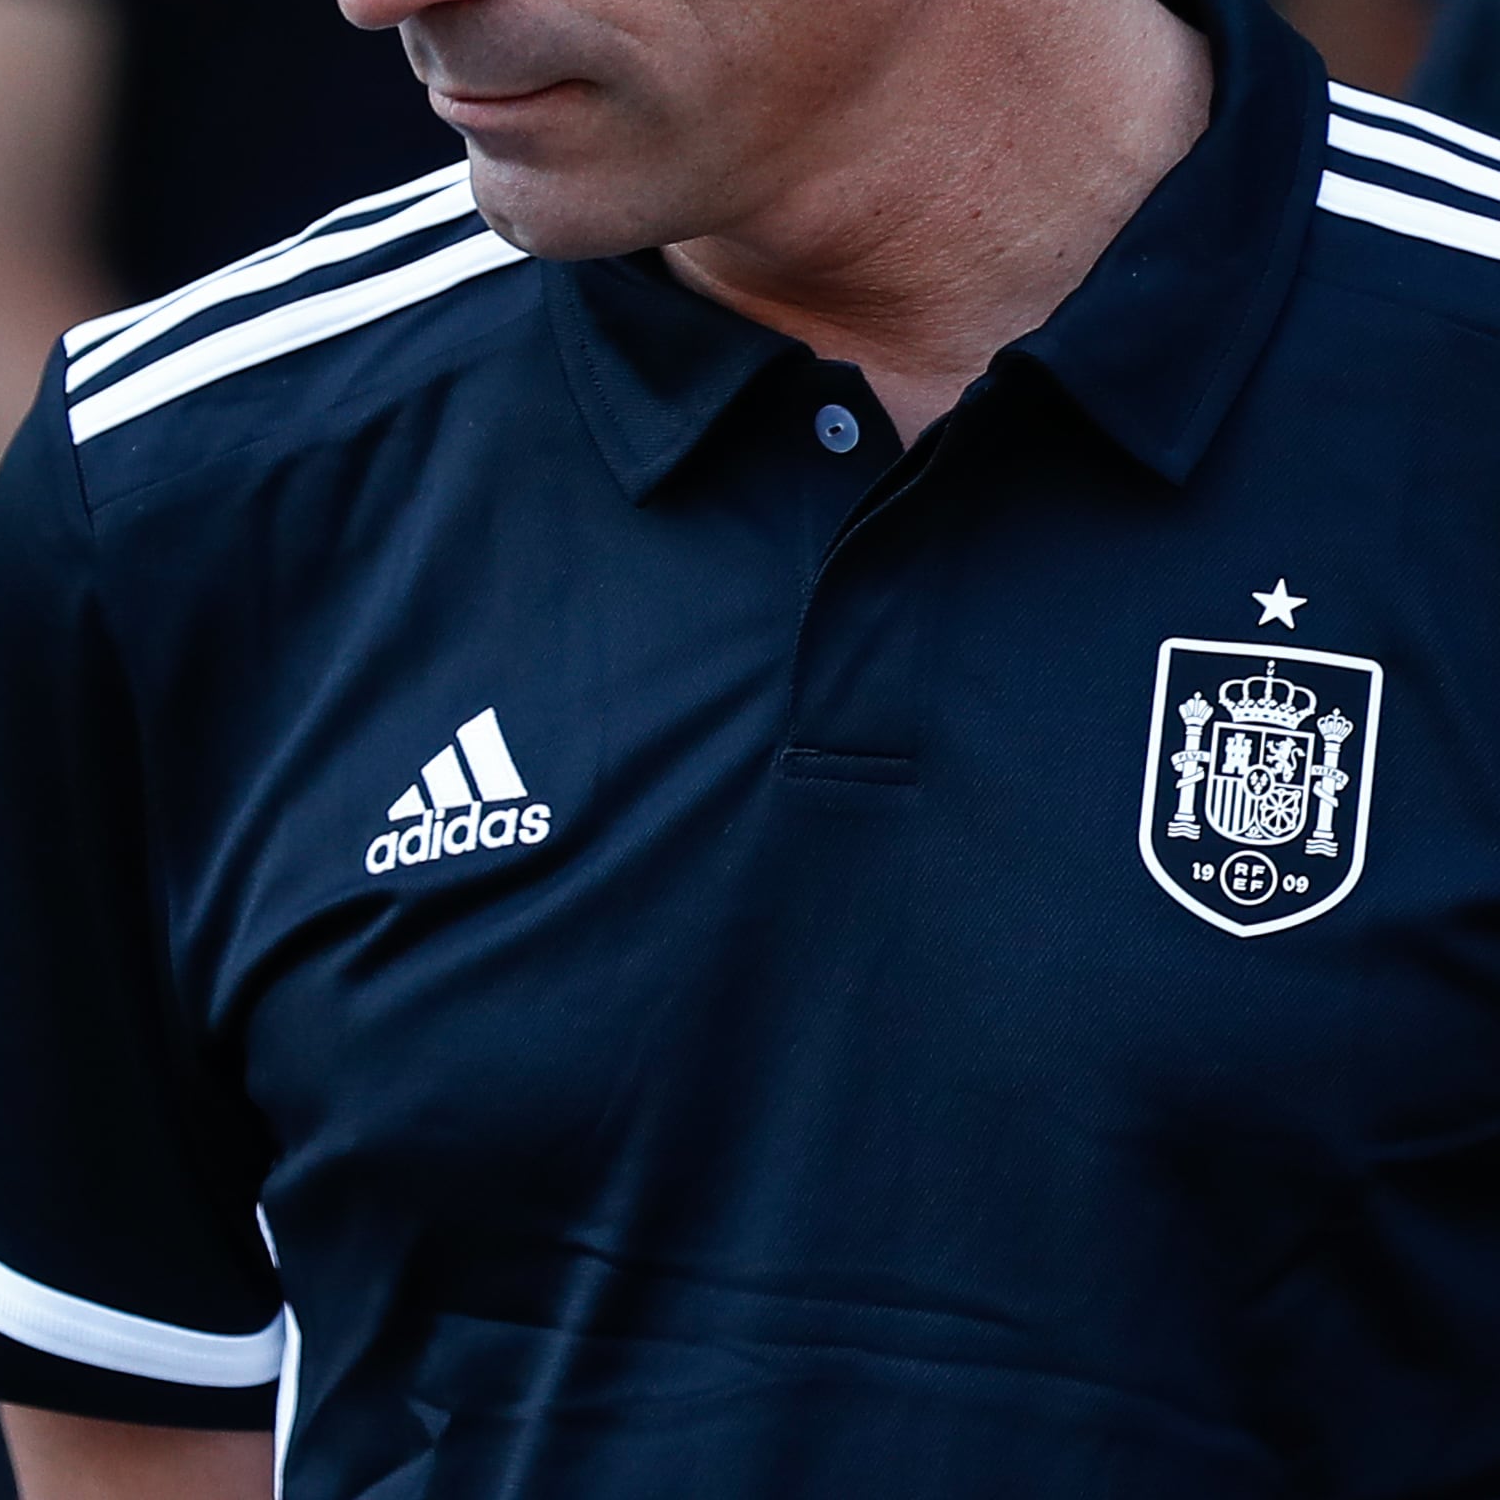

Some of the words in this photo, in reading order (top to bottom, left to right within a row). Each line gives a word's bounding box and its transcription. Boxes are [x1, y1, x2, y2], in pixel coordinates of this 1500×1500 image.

[365, 801, 551, 875] adidas
[1192, 862, 1215, 882] 19
[1282, 874, 1310, 894] 09
